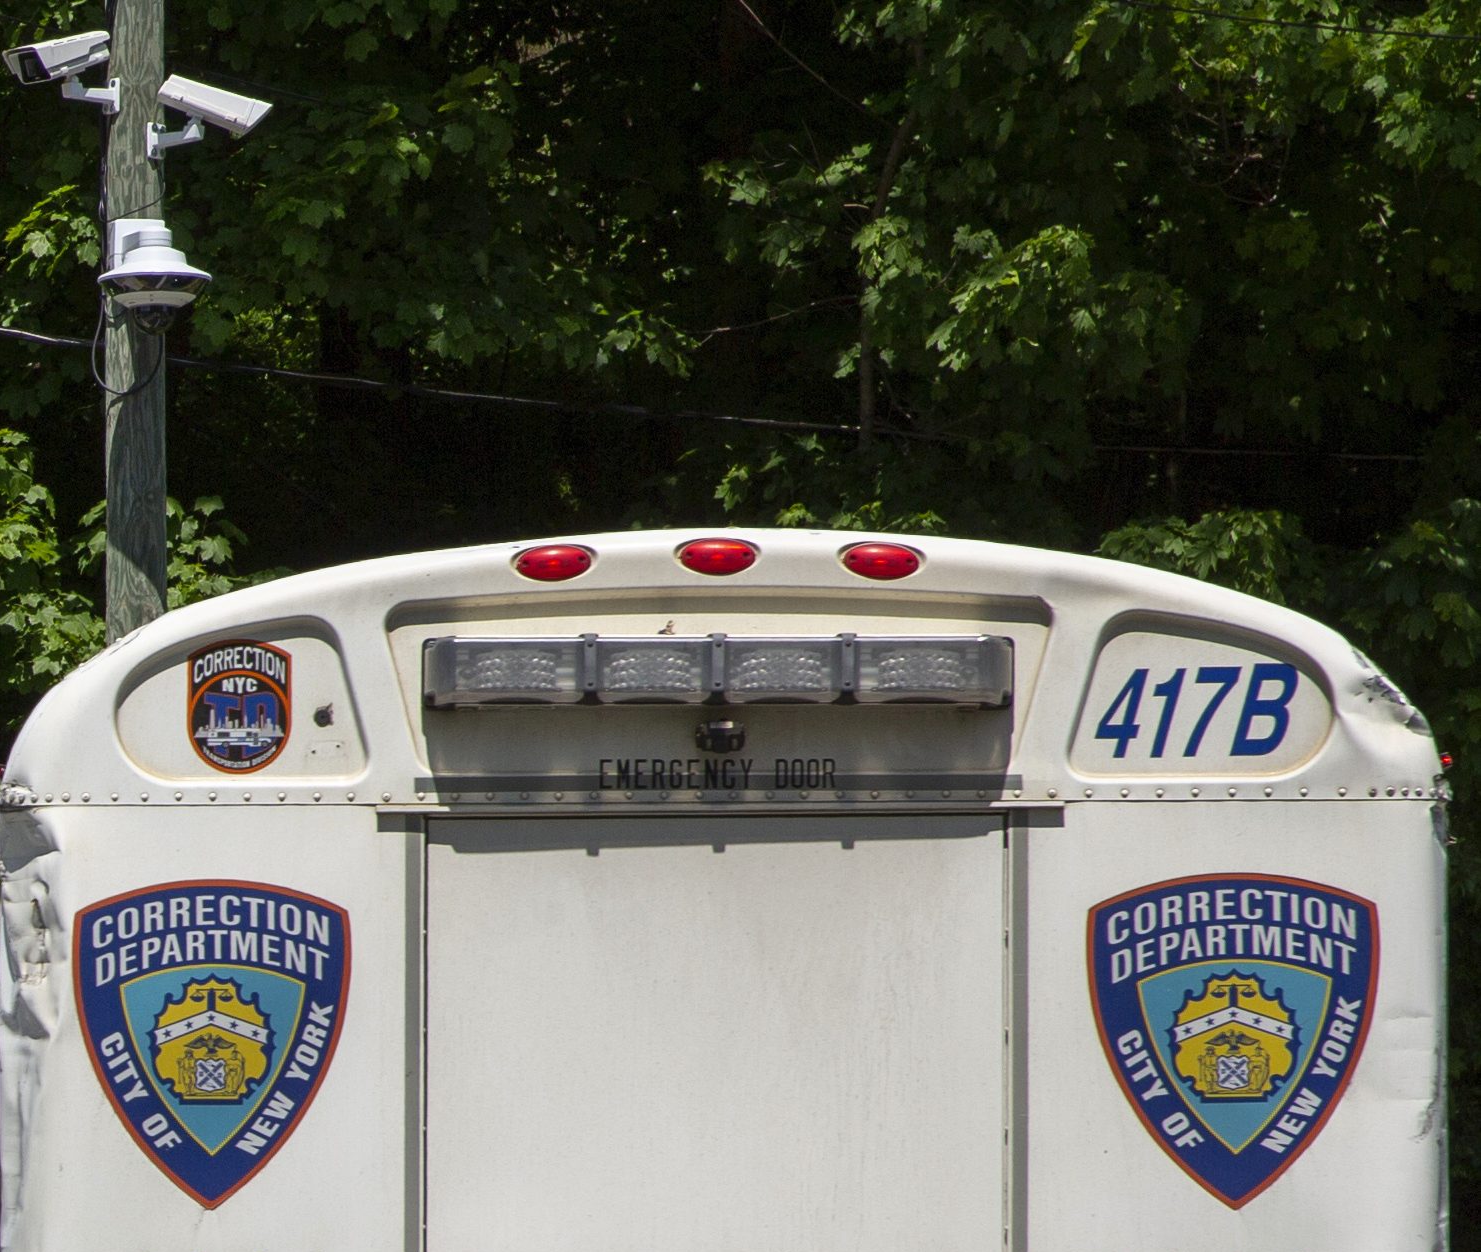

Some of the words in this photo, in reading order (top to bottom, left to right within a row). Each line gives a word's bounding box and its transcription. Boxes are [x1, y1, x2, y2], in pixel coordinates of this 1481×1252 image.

[194, 646, 286, 684] CORRECTION
[222, 677, 258, 694] NYC
[1094, 662, 1299, 758] 417B
[599, 758, 754, 790] EMERGENCY
[775, 758, 836, 790] DOOR
[92, 895, 330, 950] CORRECTION
[1106, 889, 1357, 945] CORRECTION
[95, 930, 330, 987] DEPARTMENT
[1110, 924, 1357, 984] DEPARTMENT
[100, 1031, 149, 1103] CITY
[141, 1113, 183, 1151] OF
[235, 1091, 296, 1155] NEW
[285, 1001, 335, 1083] YORK
[1117, 1028, 1169, 1101] CITY
[1161, 1112, 1205, 1149] OF
[1259, 1088, 1323, 1154] NEW
[1312, 996, 1362, 1079] YORK
